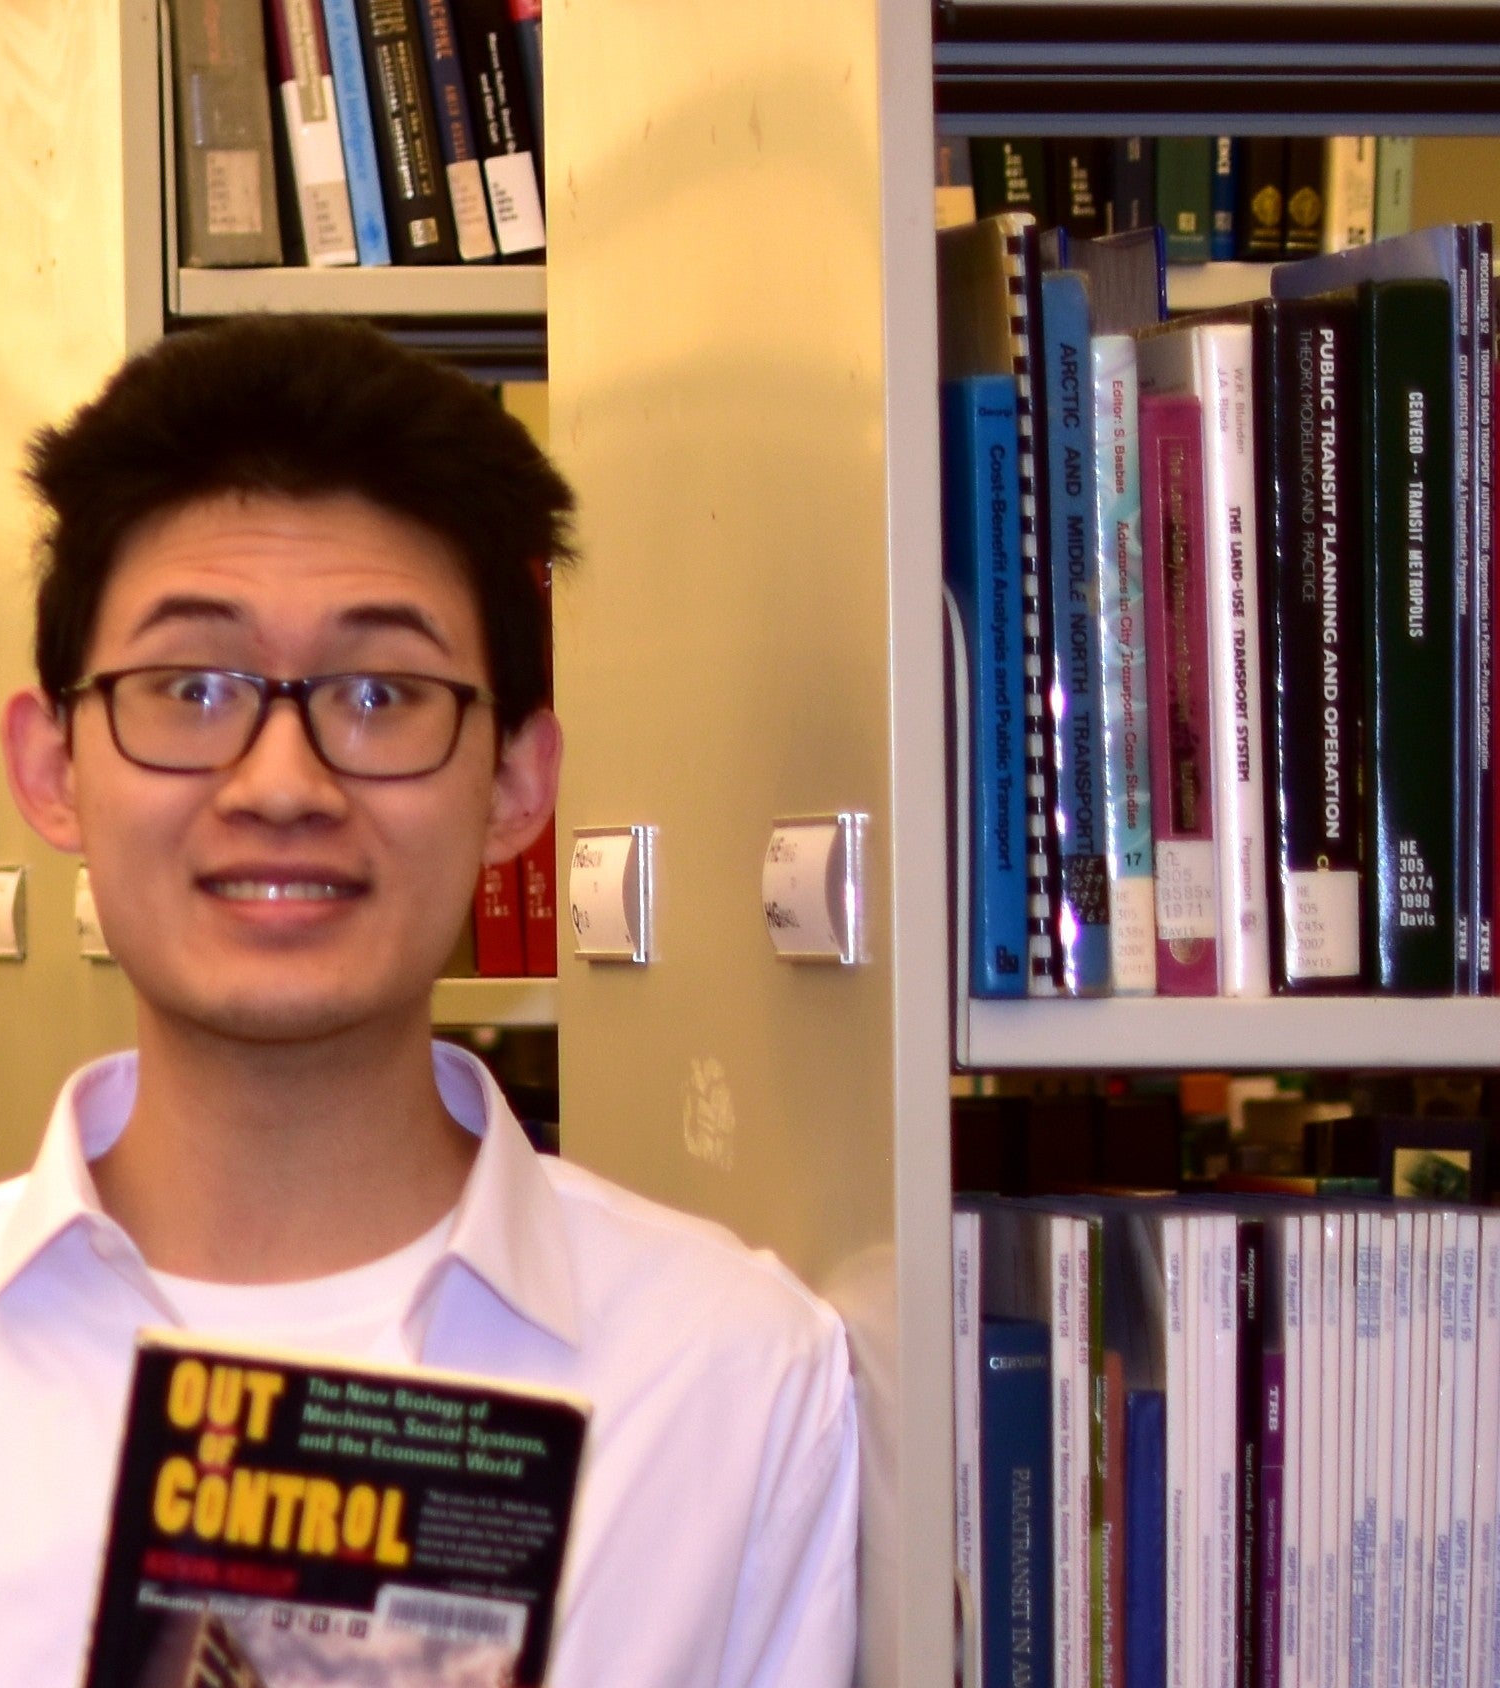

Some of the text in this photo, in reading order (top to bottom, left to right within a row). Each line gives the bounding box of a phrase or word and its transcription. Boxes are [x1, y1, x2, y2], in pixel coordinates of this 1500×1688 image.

[1059, 343, 1080, 428] ARCTIC
[1299, 393, 1315, 486] MODELLING
[1408, 391, 1424, 454] CERVERO
[1063, 447, 1082, 496] AND
[1301, 488, 1315, 523] AND
[1408, 481, 1424, 543] TRANSIT
[1067, 515, 1087, 606] MIDDLE
[1301, 532, 1316, 602] PRACTICE
[1319, 329, 1340, 838] PUBLIC TRANSIT PLANNING AND OPERATION
[1111, 380, 1139, 830] Editor: S. Basbas Advances in City Transport: Case Studies
[1408, 550, 1424, 638] METROPOLIS
[990, 444, 1014, 872] Cost-Benefit Analysis and Public Transport
[1070, 612, 1090, 695] NORTH
[1228, 506, 1249, 782] THE LAND-USE TRANSPORT SYSTEM
[1124, 852, 1143, 867] 17
[1399, 840, 1418, 856] HE
[1399, 859, 1424, 874] 305
[1163, 903, 1203, 917] 1971
[1399, 877, 1434, 892] C474
[1400, 894, 1430, 909] 1998
[1399, 912, 1435, 928] Davis
[166, 1358, 285, 1443] OUT
[307, 1375, 489, 1421] The New Biology of
[199, 1429, 238, 1465] OF
[299, 1431, 524, 1478] and the Economic World
[301, 1402, 549, 1459] Machines, Social Systems,
[152, 1457, 410, 1566] CONTROL
[1012, 1468, 1031, 1620] PARATRANSIT
[1101, 1522, 1113, 1581] Driving
[1101, 1584, 1113, 1612] and
[1012, 1626, 1031, 1654] IN
[1101, 1615, 1113, 1641] the
[1101, 1645, 1113, 1680] Built
